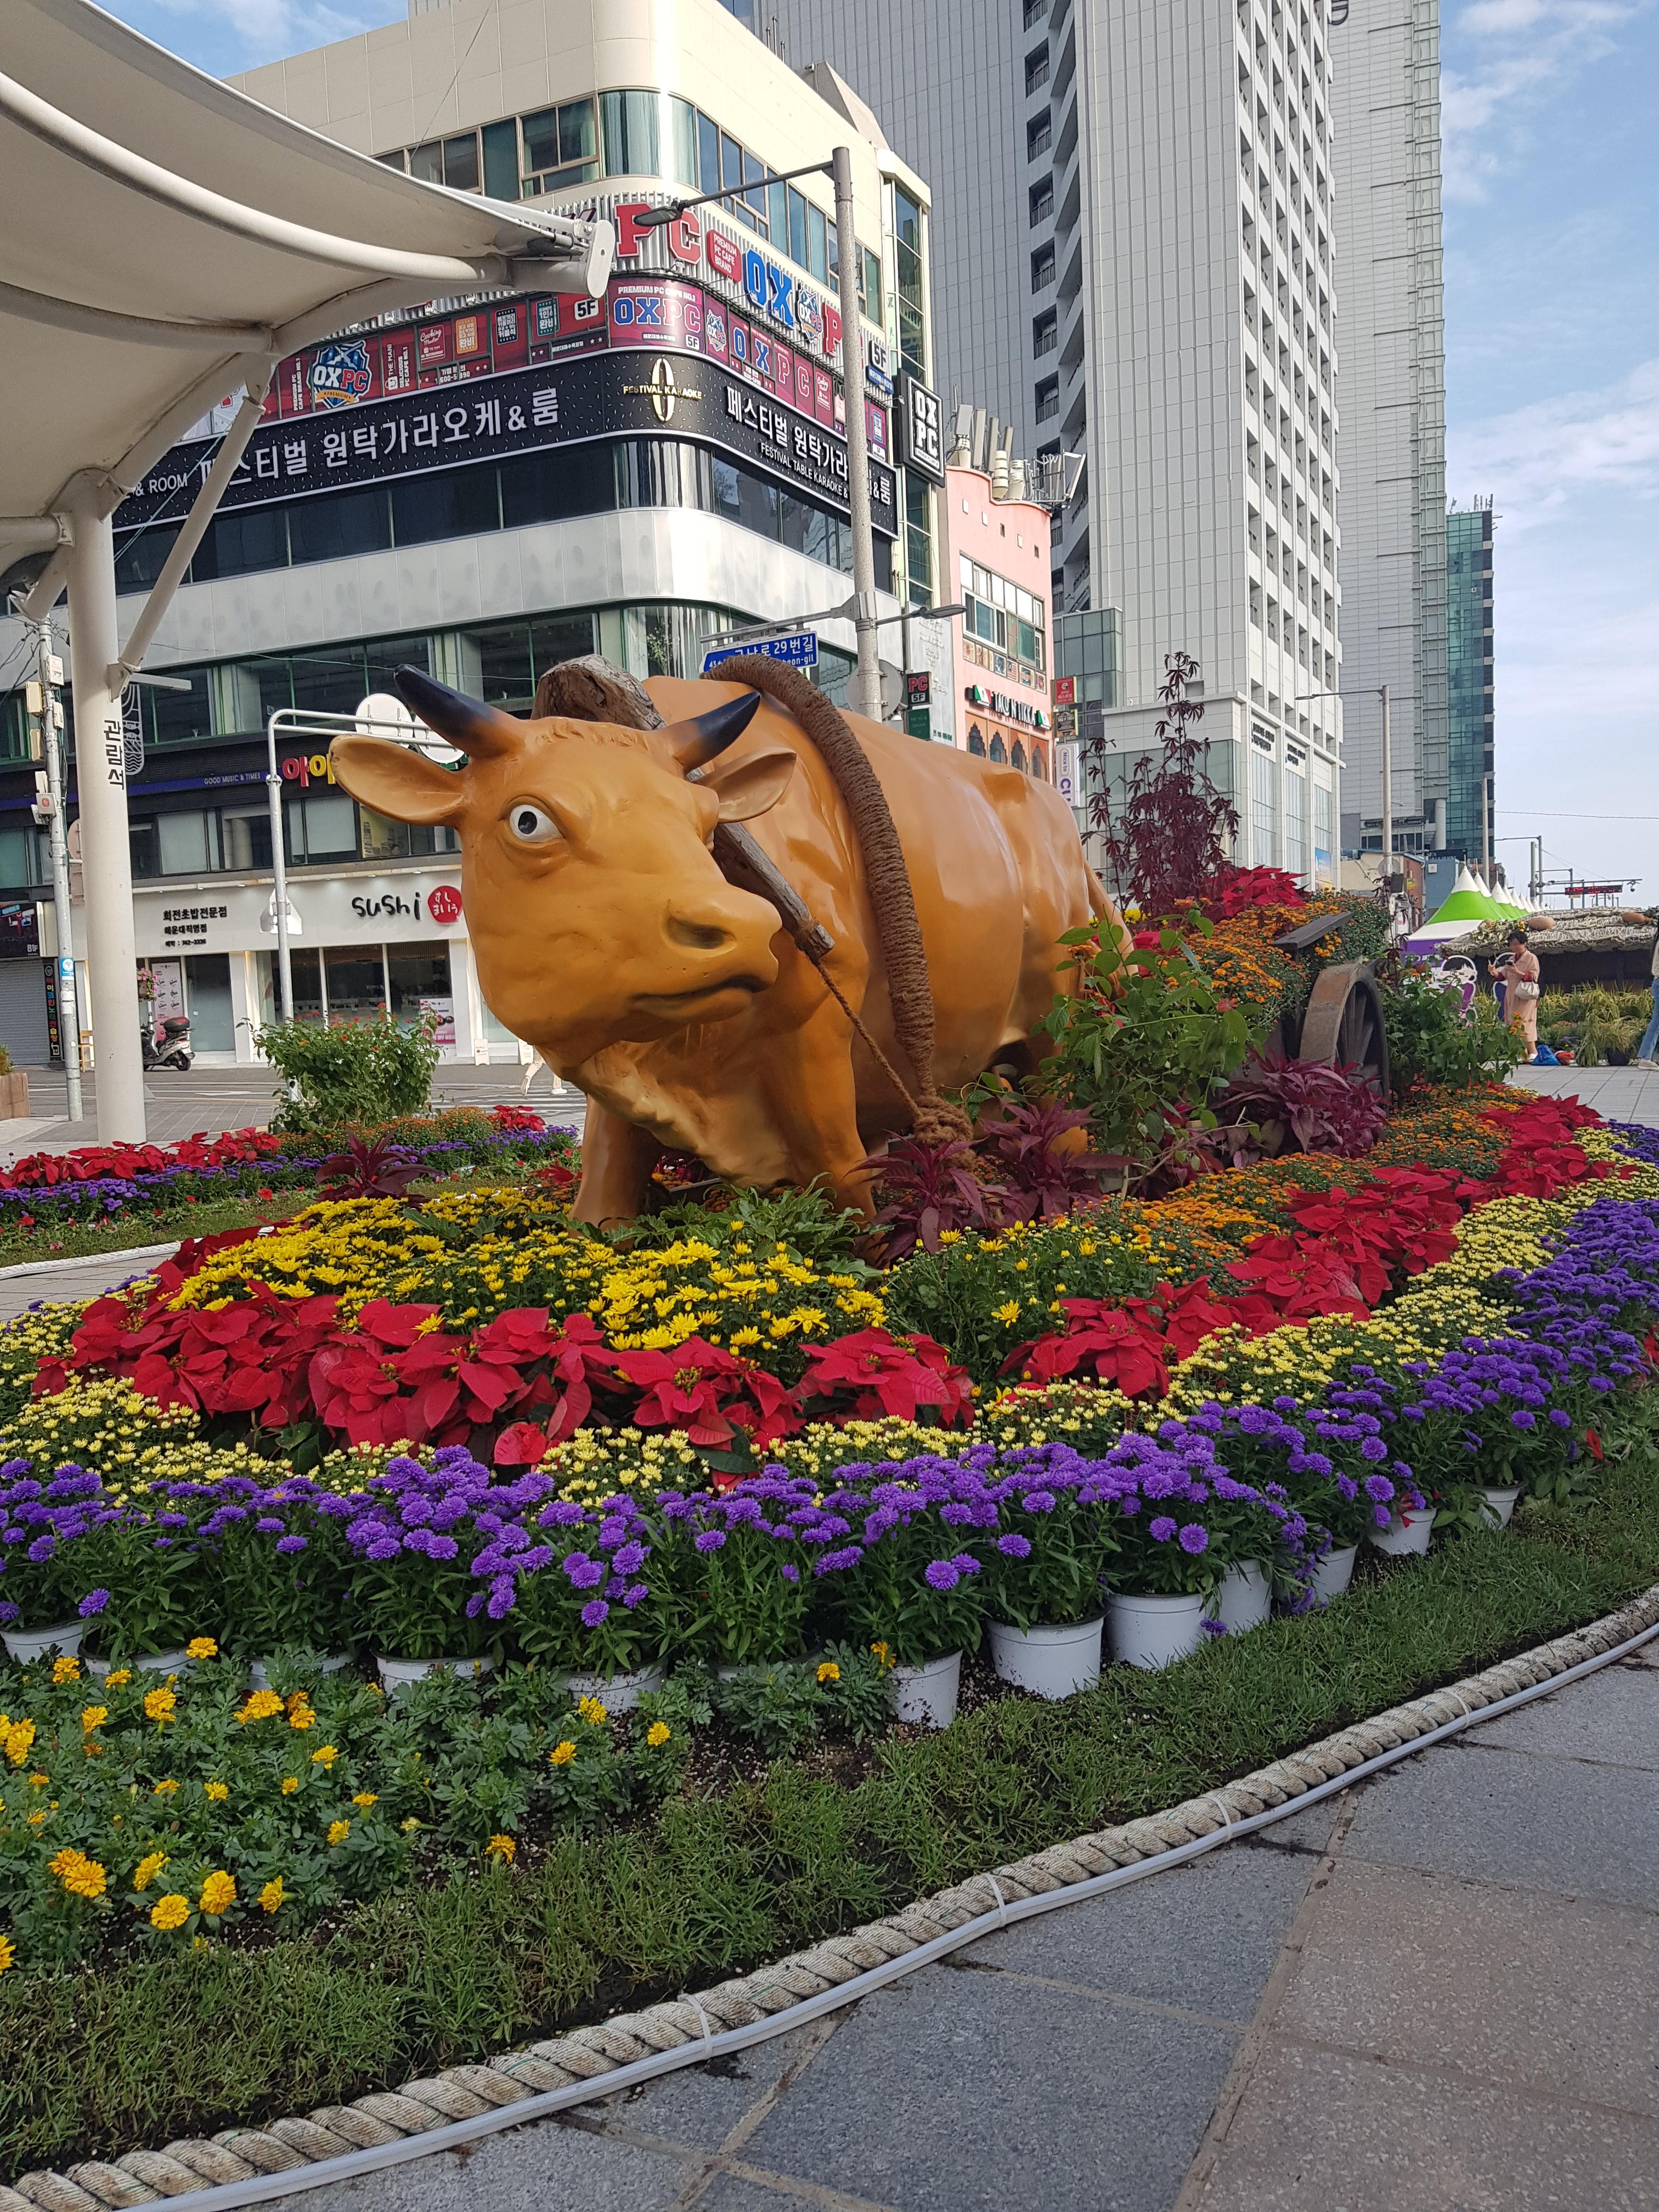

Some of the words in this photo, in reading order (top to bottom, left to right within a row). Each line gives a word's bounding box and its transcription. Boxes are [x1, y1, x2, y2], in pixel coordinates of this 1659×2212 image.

[615, 202, 701, 265] PC
[714, 234, 737, 256] PREMIUM
[715, 246, 722, 258] PC
[722, 250, 735, 266] CAFE
[715, 258, 732, 274] BRAND
[618, 285, 653, 294] PREMIUM
[743, 248, 795, 330] OX
[578, 300, 596, 318] 5F
[614, 297, 701, 334] OXPC
[799, 302, 821, 331] OXPC
[420, 329, 442, 342] Cooking
[687, 336, 698, 348] 5F
[708, 324, 725, 343] OXPC
[874, 342, 887, 369] 5F
[291, 374, 297, 383] PC
[313, 365, 369, 391] OXPC
[404, 378, 410, 387] PC
[326, 391, 348, 399] PREMIUM
[623, 385, 663, 394] FESTIVAL
[664, 386, 702, 400] KARAOKE
[727, 386, 788, 448] 페스티벌
[915, 390, 937, 428] OX
[916, 419, 938, 458] PC
[761, 442, 792, 469] FESTIVAL
[793, 460, 812, 480] TABLE
[813, 472, 842, 495] KARAOKE
[149, 472, 188, 494] ROOM
[709, 661, 716, 669] 43
[908, 676, 928, 692] PC
[913, 693, 923, 702] 5F
[991, 691, 1010, 716] TACO
[1016, 701, 1036, 726] TIKKA
[104, 720, 125, 791] 관람석
[204, 776, 221, 785] GOOD
[222, 775, 239, 783] MUSIC
[246, 772, 261, 780] TIMES
[435, 891, 452, 904] すし
[163, 906, 227, 921] 회전초밥전문점
[165, 923, 207, 934] 해운대직영점
[27, 944, 38, 952] B1F
